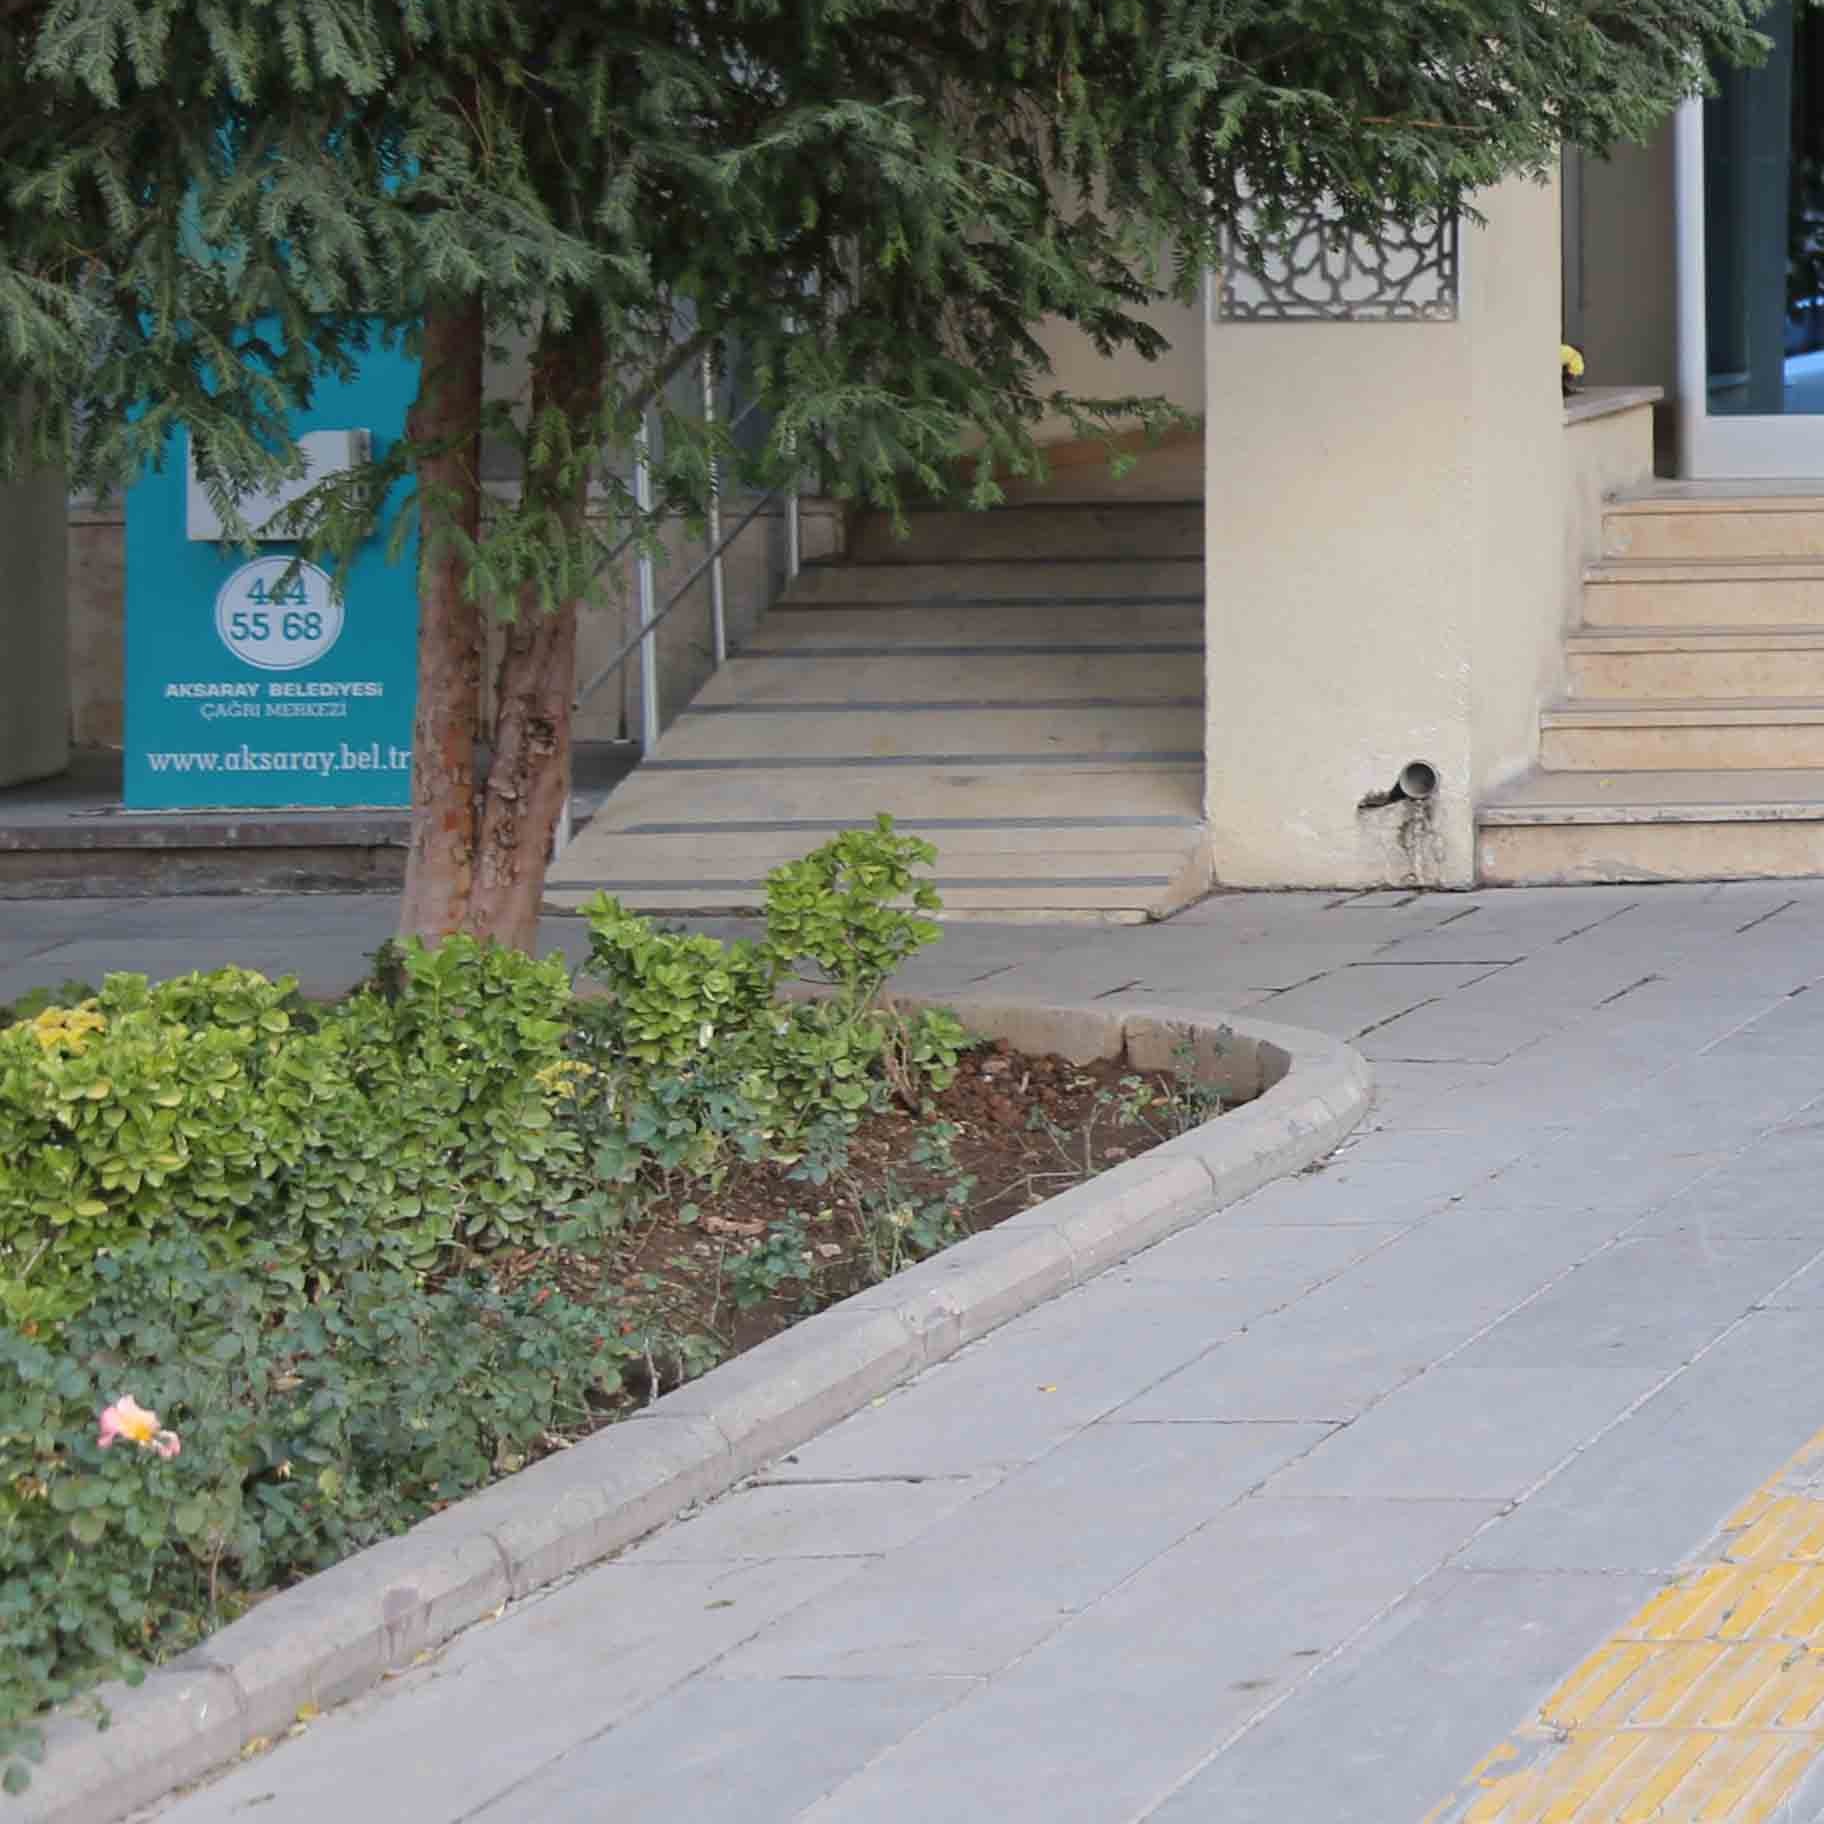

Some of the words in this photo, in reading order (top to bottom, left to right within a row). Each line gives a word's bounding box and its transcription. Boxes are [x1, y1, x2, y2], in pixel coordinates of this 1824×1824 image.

[229, 612, 271, 641] 55
[281, 612, 324, 641] 68
[163, 683, 260, 698] AKSARAY
[200, 701, 261, 721] ÇAĞRI
[147, 742, 413, 778] www.aksaray.bel.tr
